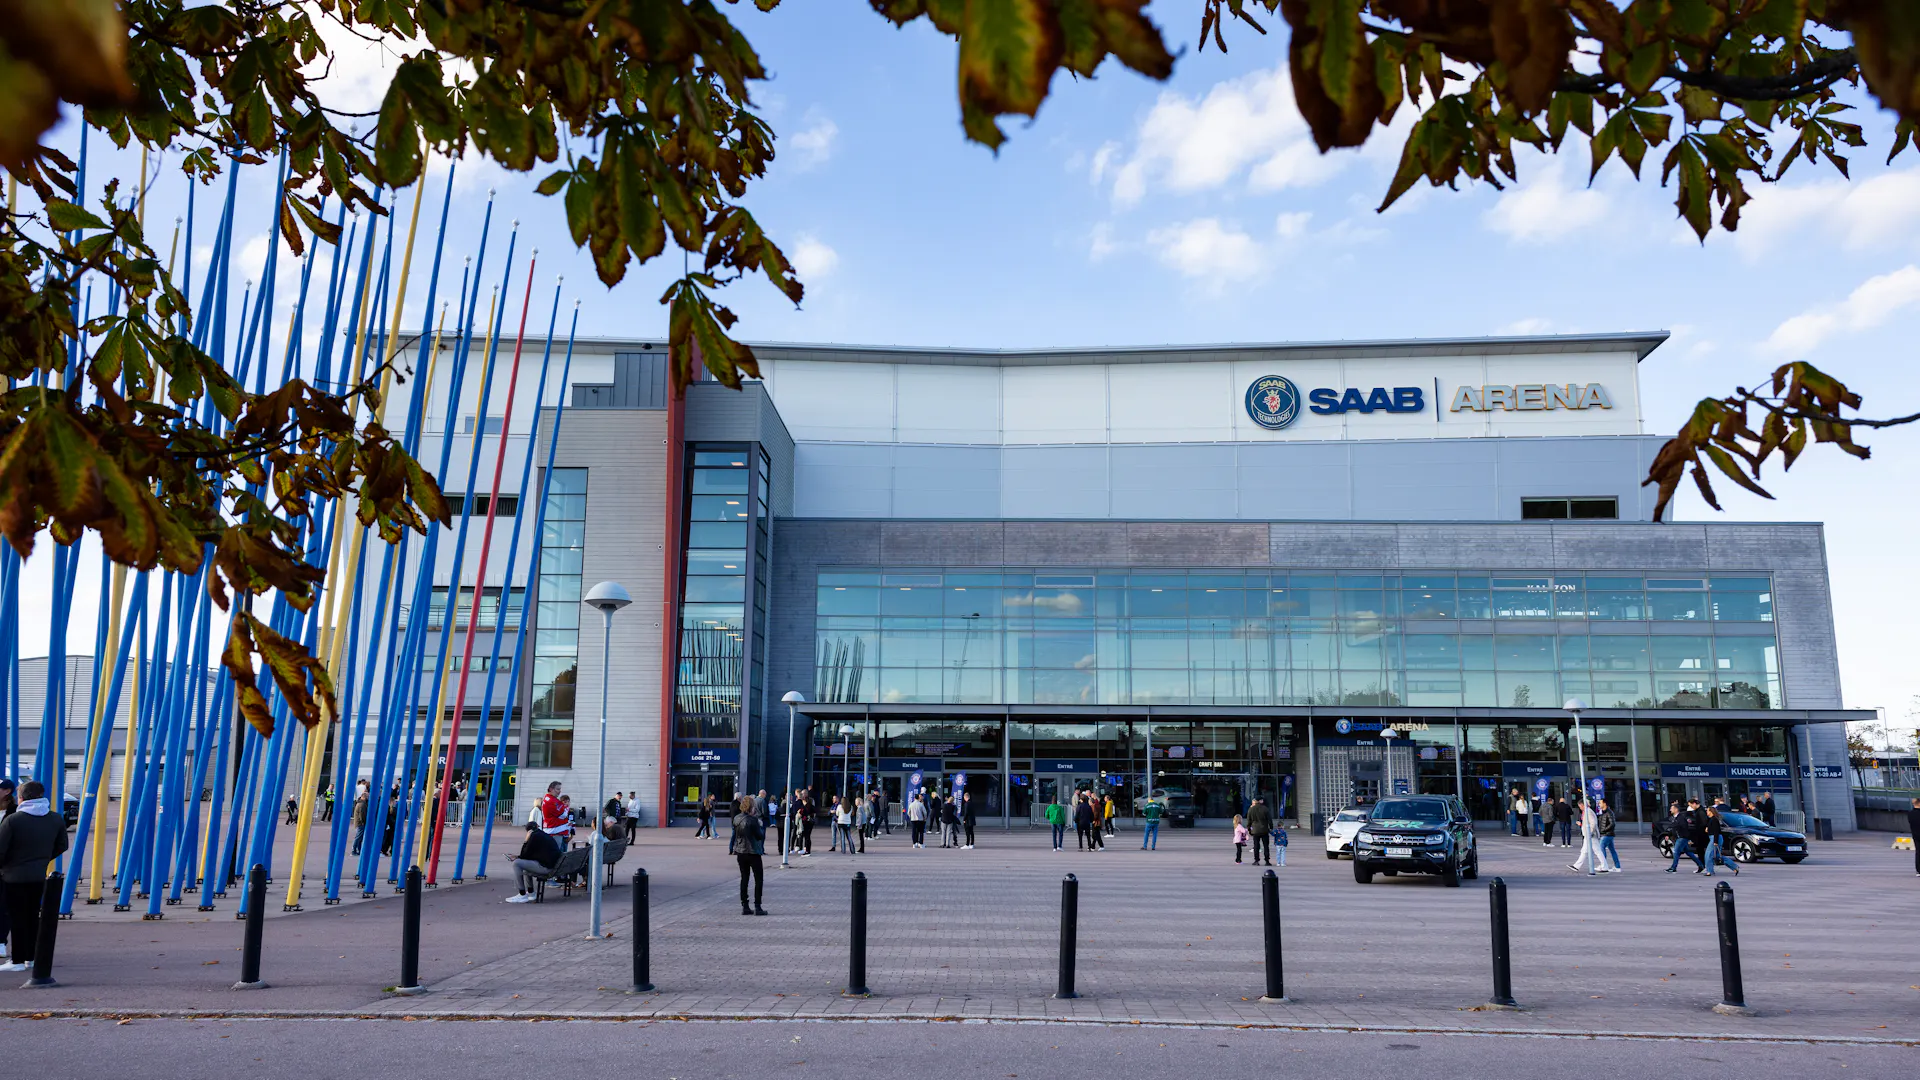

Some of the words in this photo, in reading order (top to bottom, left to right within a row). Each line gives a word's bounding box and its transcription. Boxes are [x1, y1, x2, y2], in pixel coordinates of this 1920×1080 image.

[1259, 380, 1286, 390] SAAB
[1308, 387, 1425, 415] SAAB
[1449, 383, 1613, 412] ARENA
[1353, 723, 1383, 731] SAAB
[1389, 723, 1429, 731] ARENA
[1731, 768, 1787, 776] KUNDCENTER
